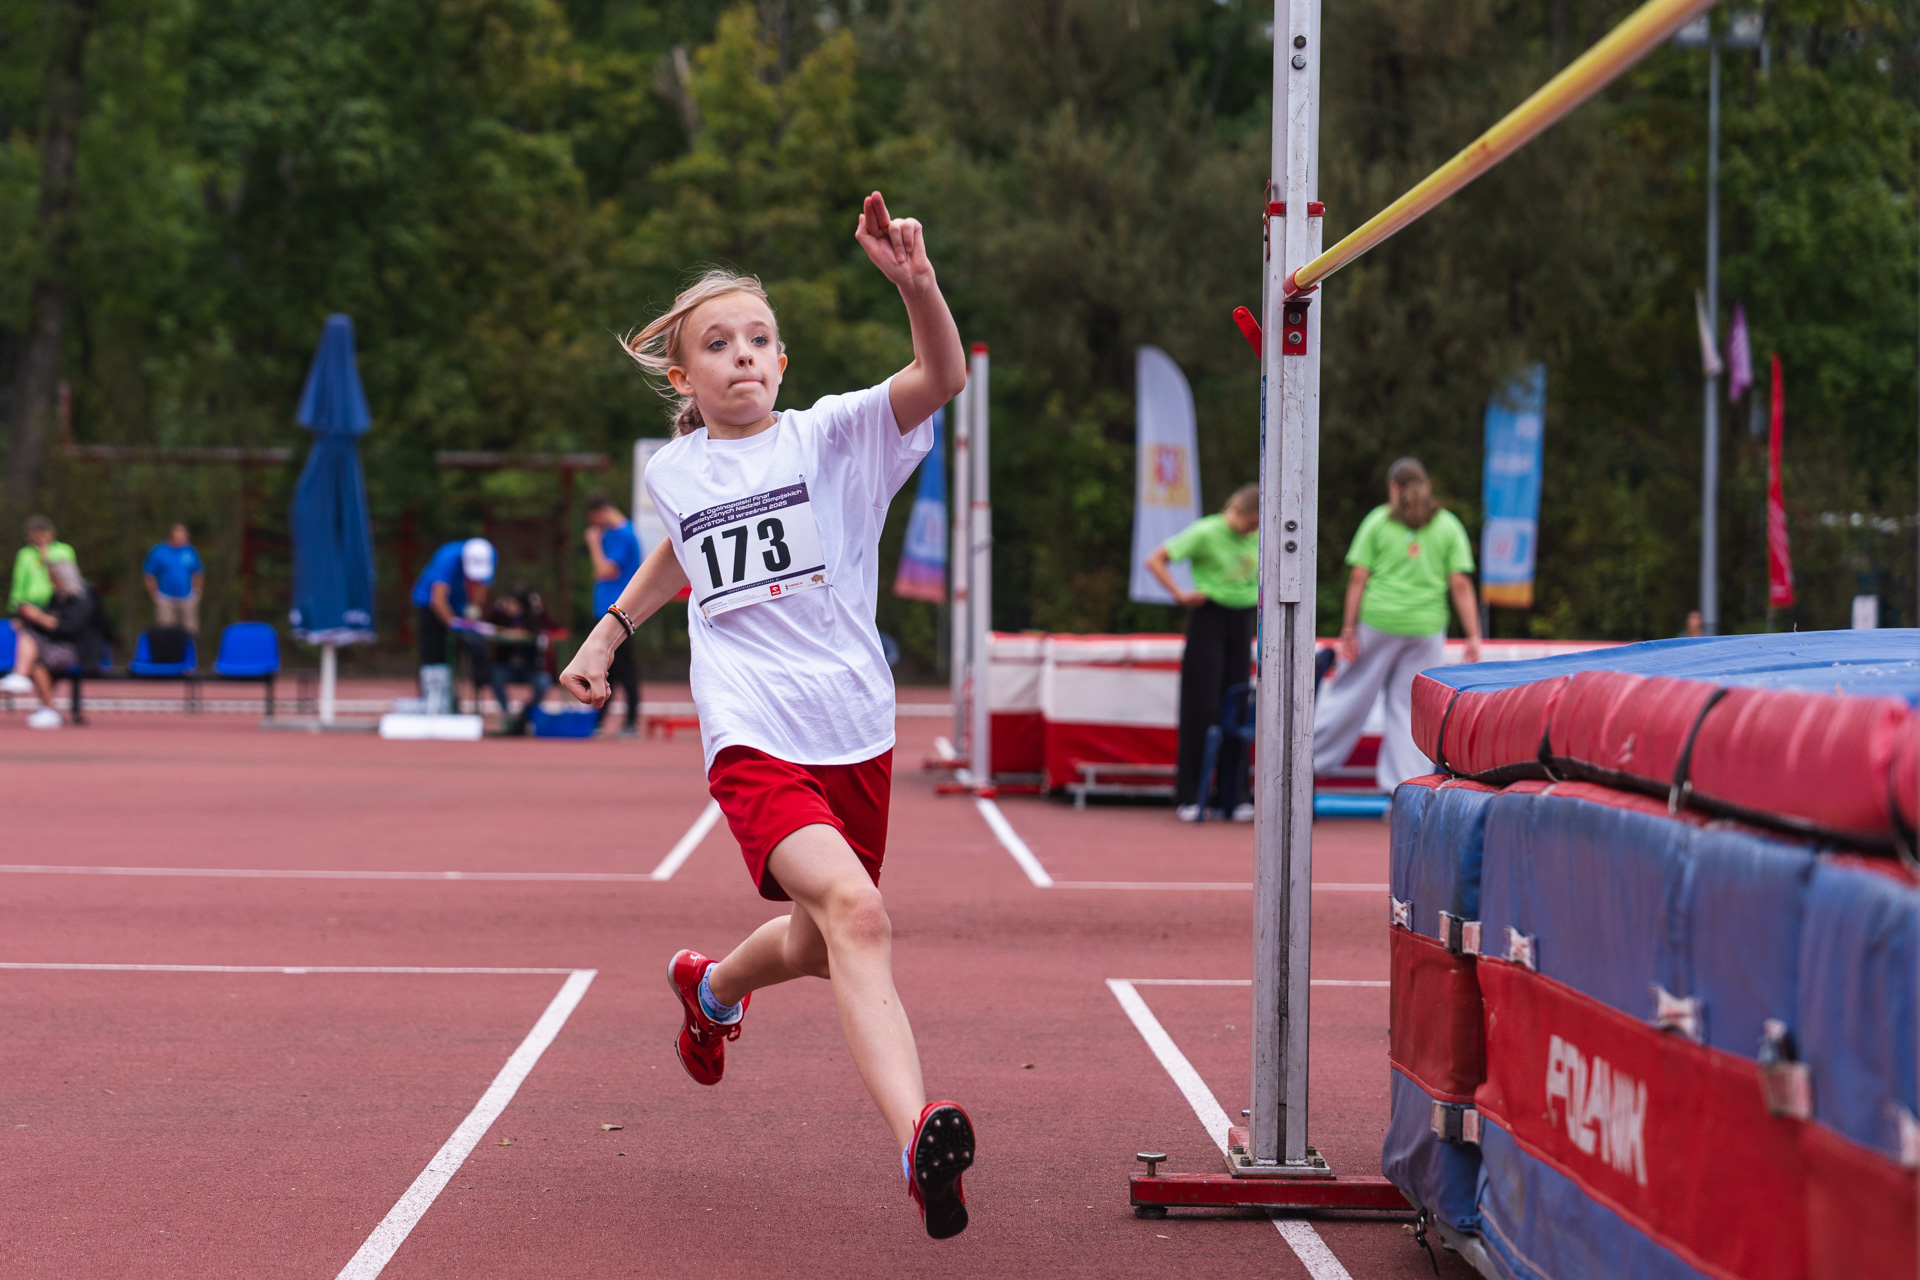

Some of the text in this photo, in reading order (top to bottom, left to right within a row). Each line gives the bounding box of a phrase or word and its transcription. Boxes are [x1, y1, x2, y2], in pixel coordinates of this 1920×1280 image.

[706, 498, 752, 515] Ogólnopolski
[735, 501, 761, 512] Nadziei
[762, 489, 803, 505] Olimpijskich
[735, 506, 768, 519] września
[768, 500, 788, 510] 2025
[700, 517, 791, 589] 173
